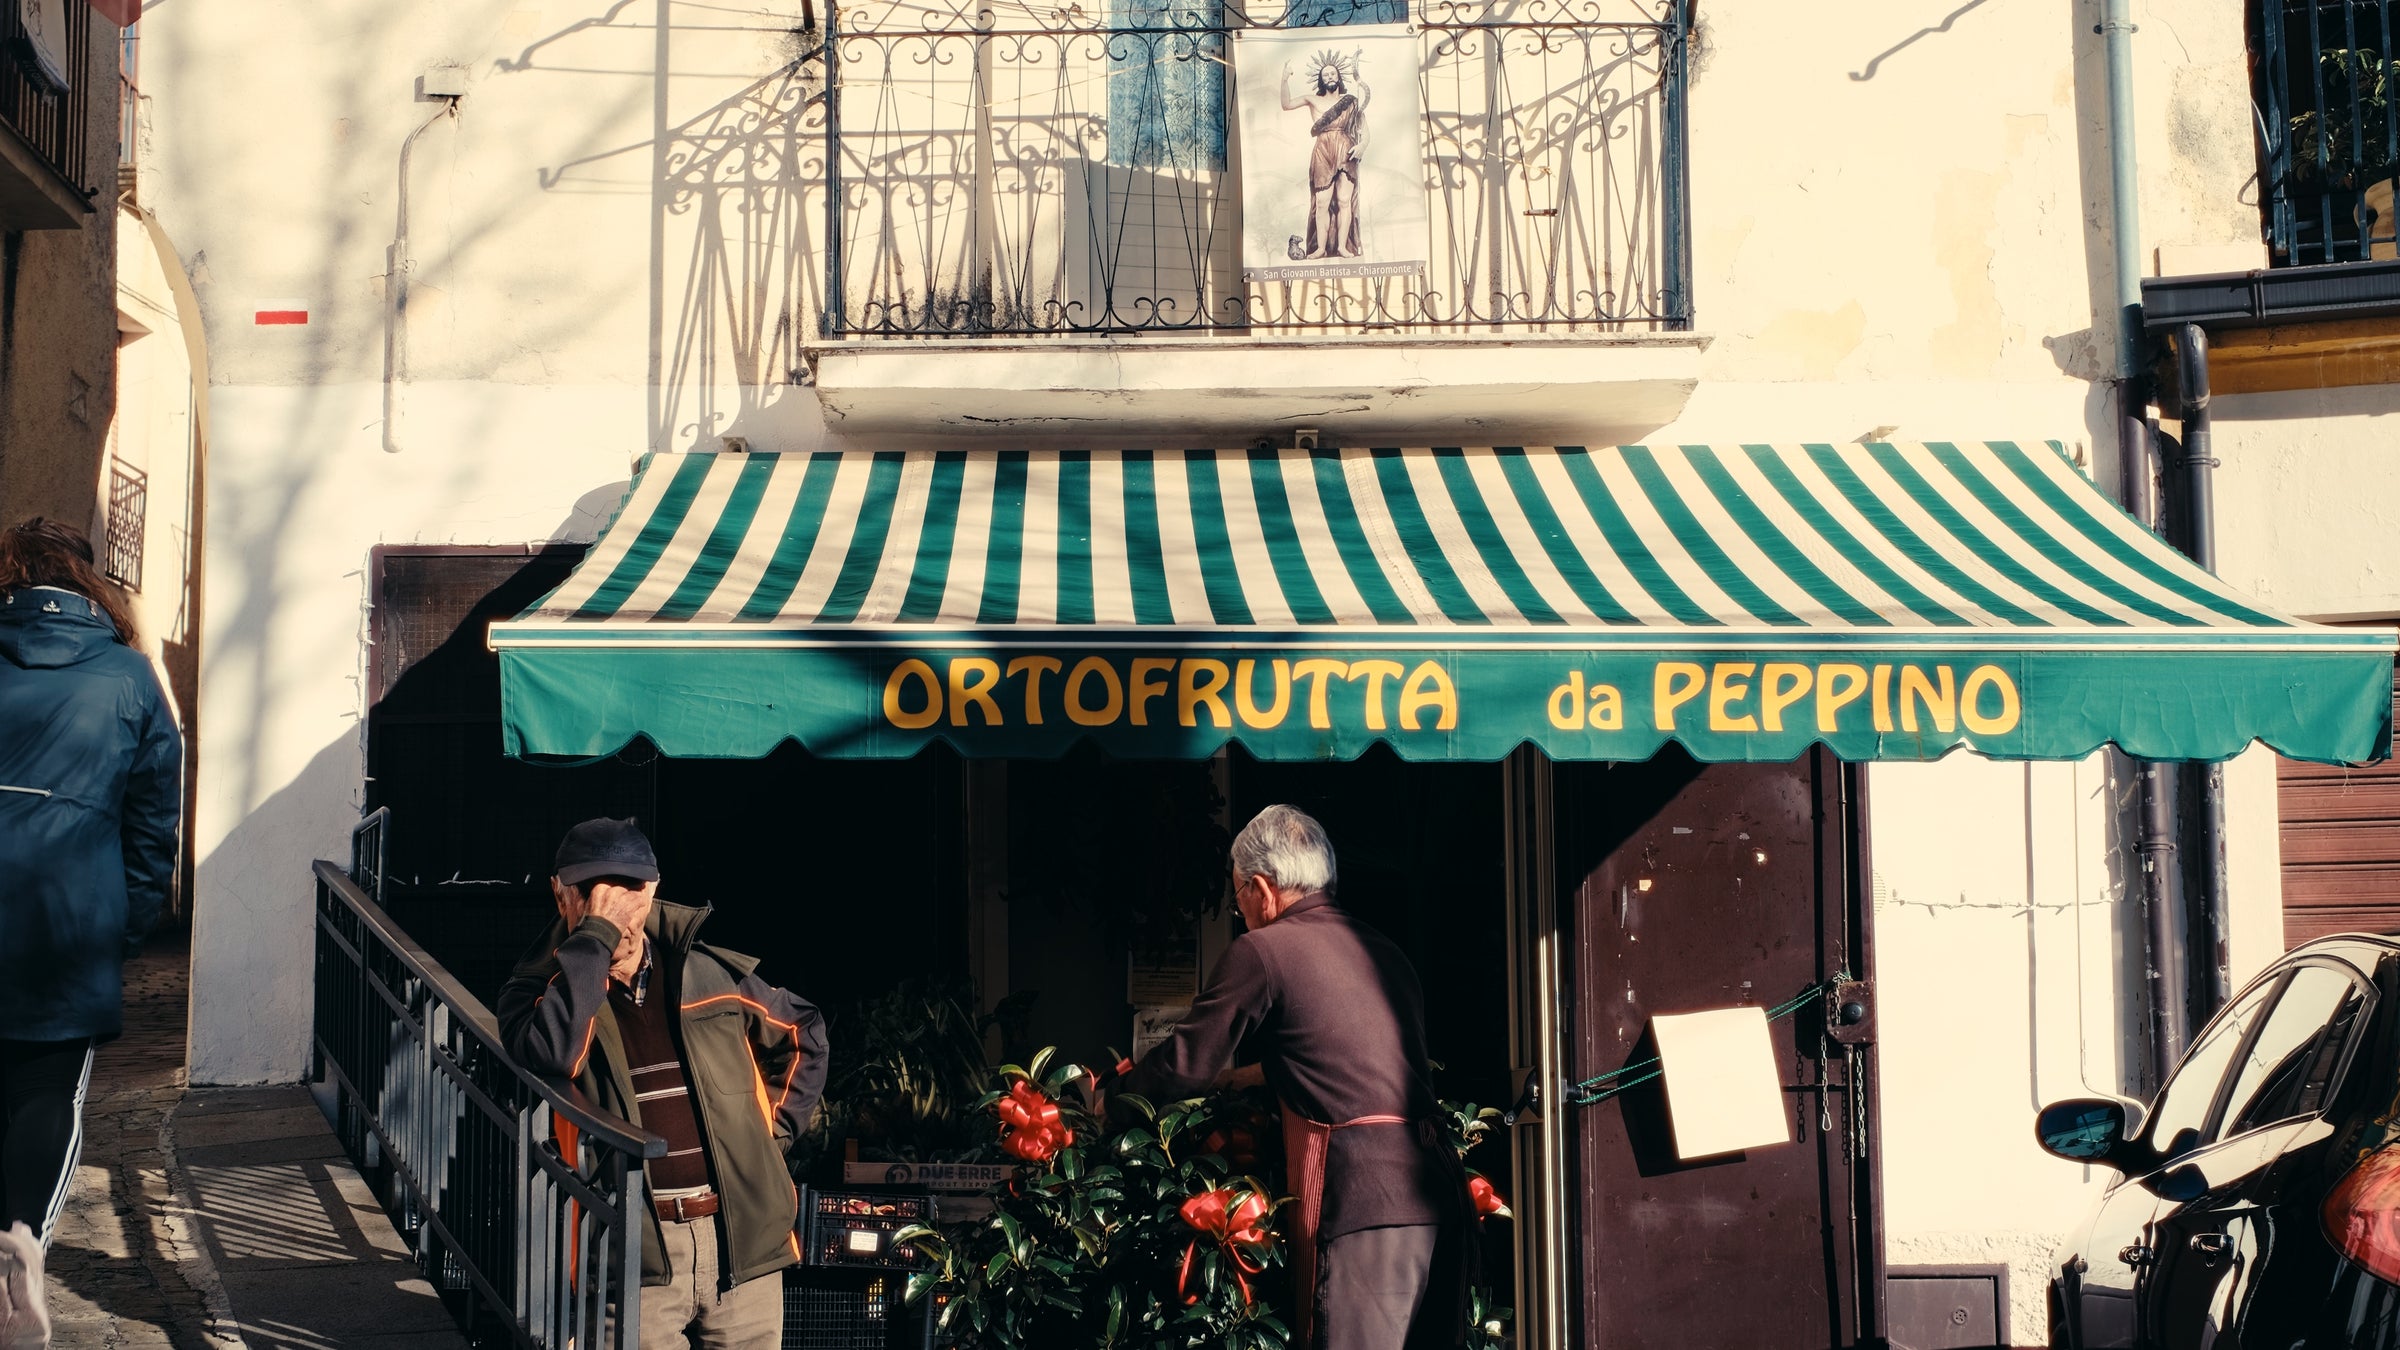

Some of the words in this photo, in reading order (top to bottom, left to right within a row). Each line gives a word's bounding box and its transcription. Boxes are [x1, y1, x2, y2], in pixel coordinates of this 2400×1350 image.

[1263, 270, 1279, 280] San
[1281, 267, 1317, 278] Giovanni
[1319, 266, 1351, 277] Battista
[1358, 264, 1412, 276] Chiaromonte
[883, 655, 1457, 730] ORTOFRUTTA
[1547, 671, 1623, 731] da
[1654, 662, 2021, 735] PEPPINO
